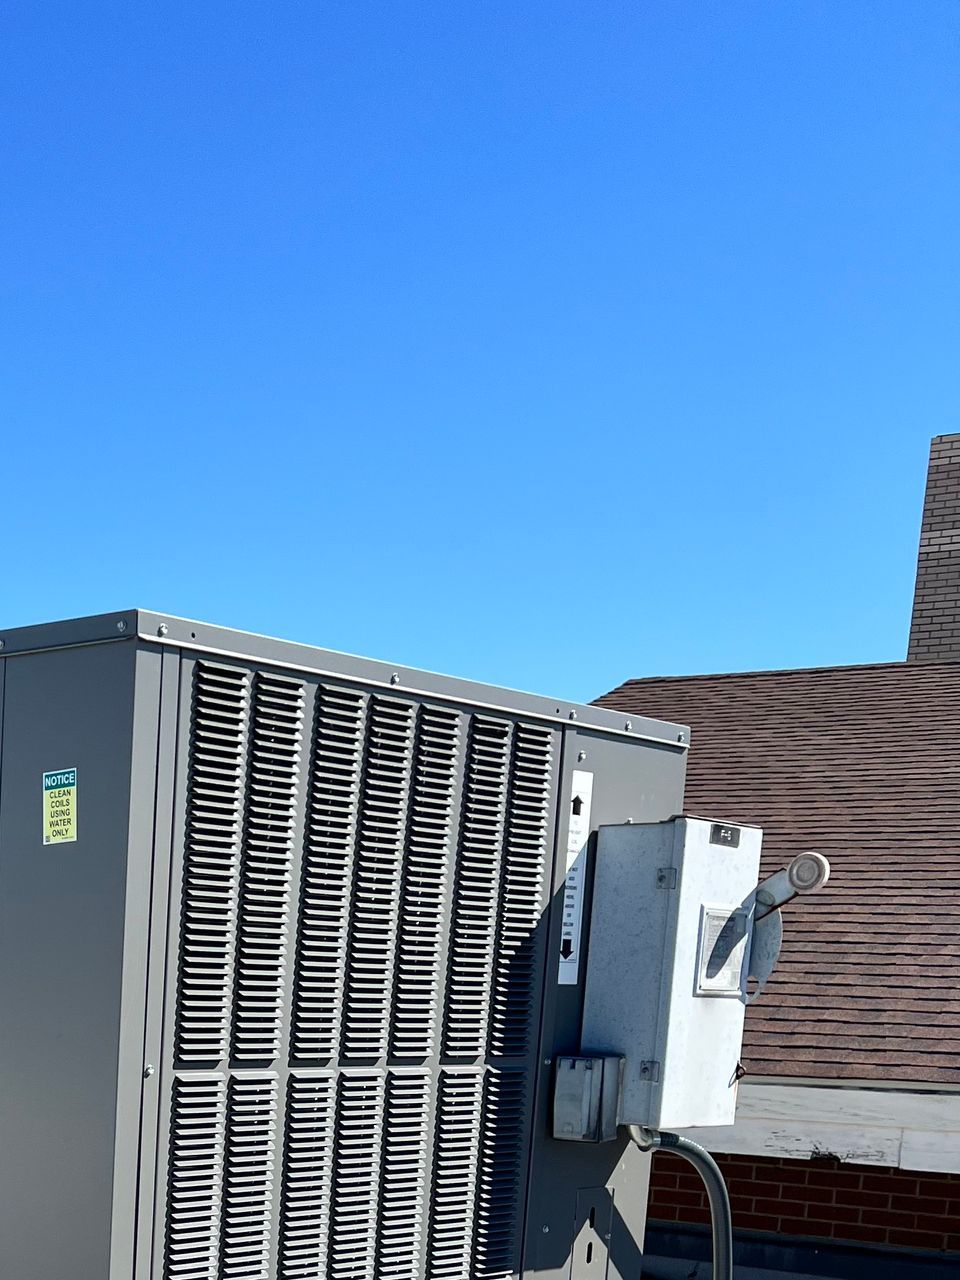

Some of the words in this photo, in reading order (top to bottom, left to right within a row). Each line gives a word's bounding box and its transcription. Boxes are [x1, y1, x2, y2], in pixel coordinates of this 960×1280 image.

[45, 773, 75, 787] NOTICE
[49, 789, 71, 799] CLEAN
[50, 799, 70, 809] COILS
[50, 809, 70, 819] USING
[49, 818, 72, 828] WATER
[51, 828, 69, 837] ONLY
